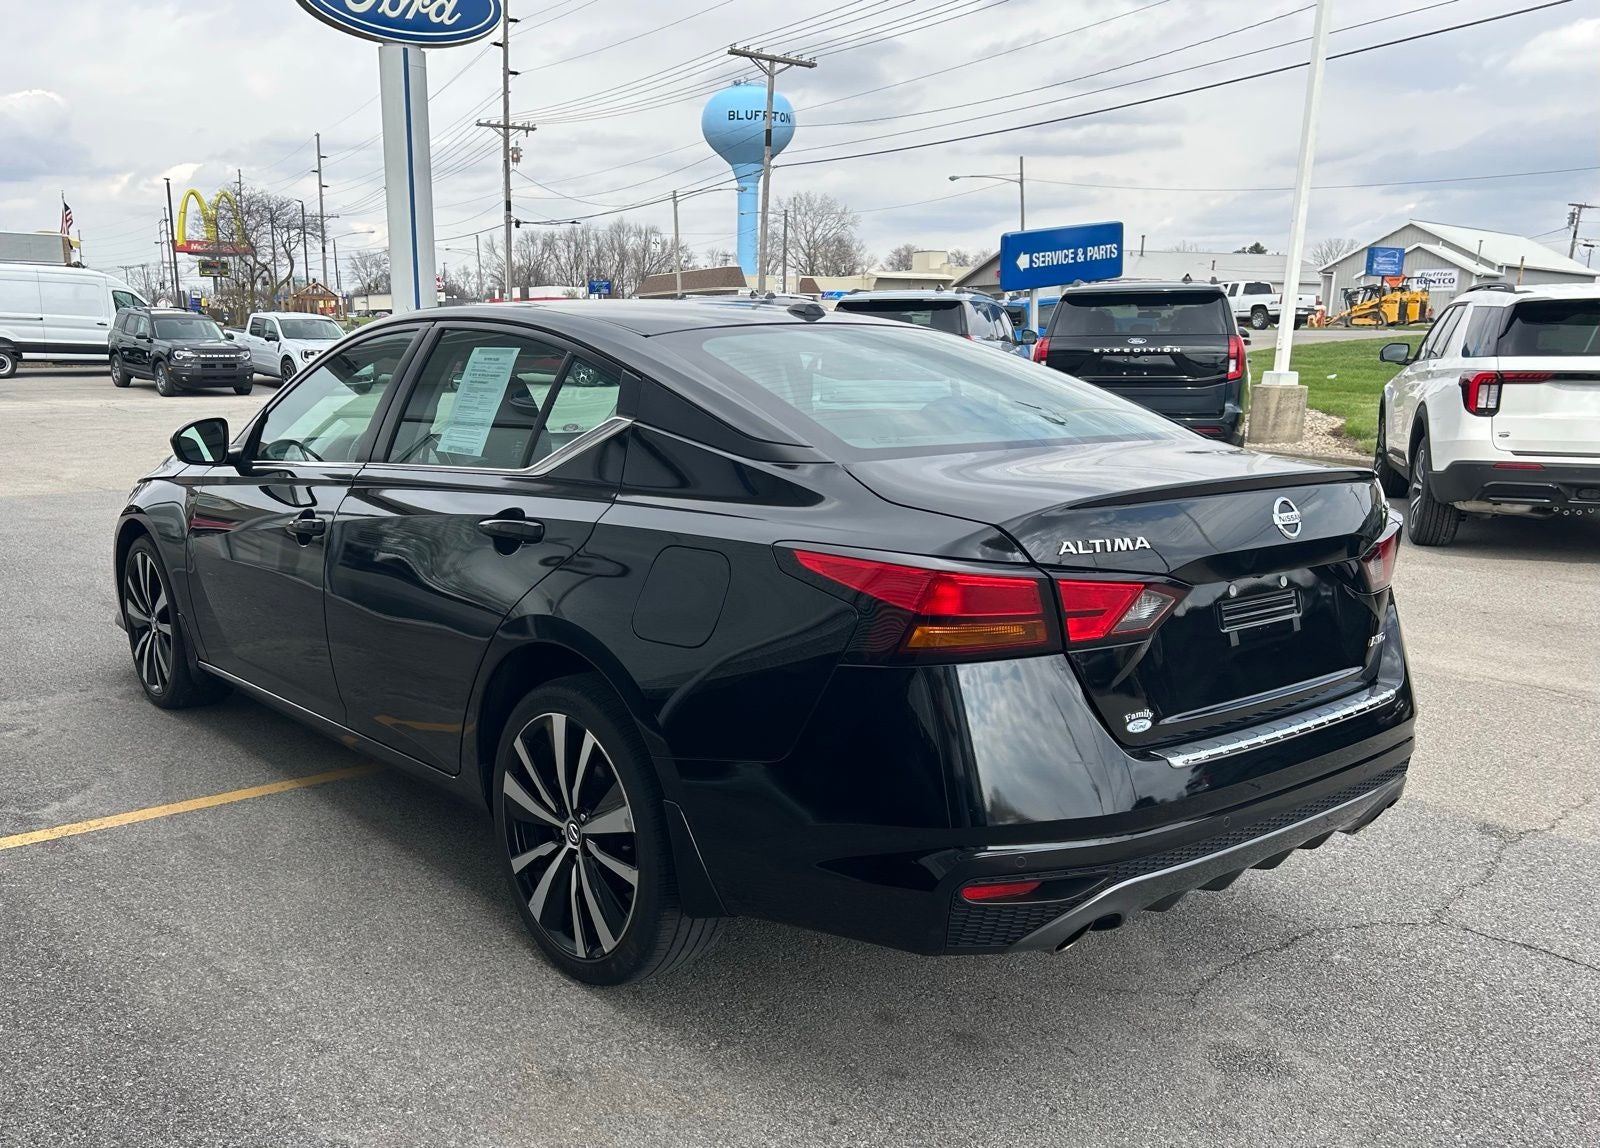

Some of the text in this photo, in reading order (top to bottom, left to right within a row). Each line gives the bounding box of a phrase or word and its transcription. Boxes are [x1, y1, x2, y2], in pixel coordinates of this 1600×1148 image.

[1032, 244, 1118, 268] SERVICE & PARTS
[1058, 536, 1151, 555] ALTIMA
[1124, 709, 1154, 723] Family
